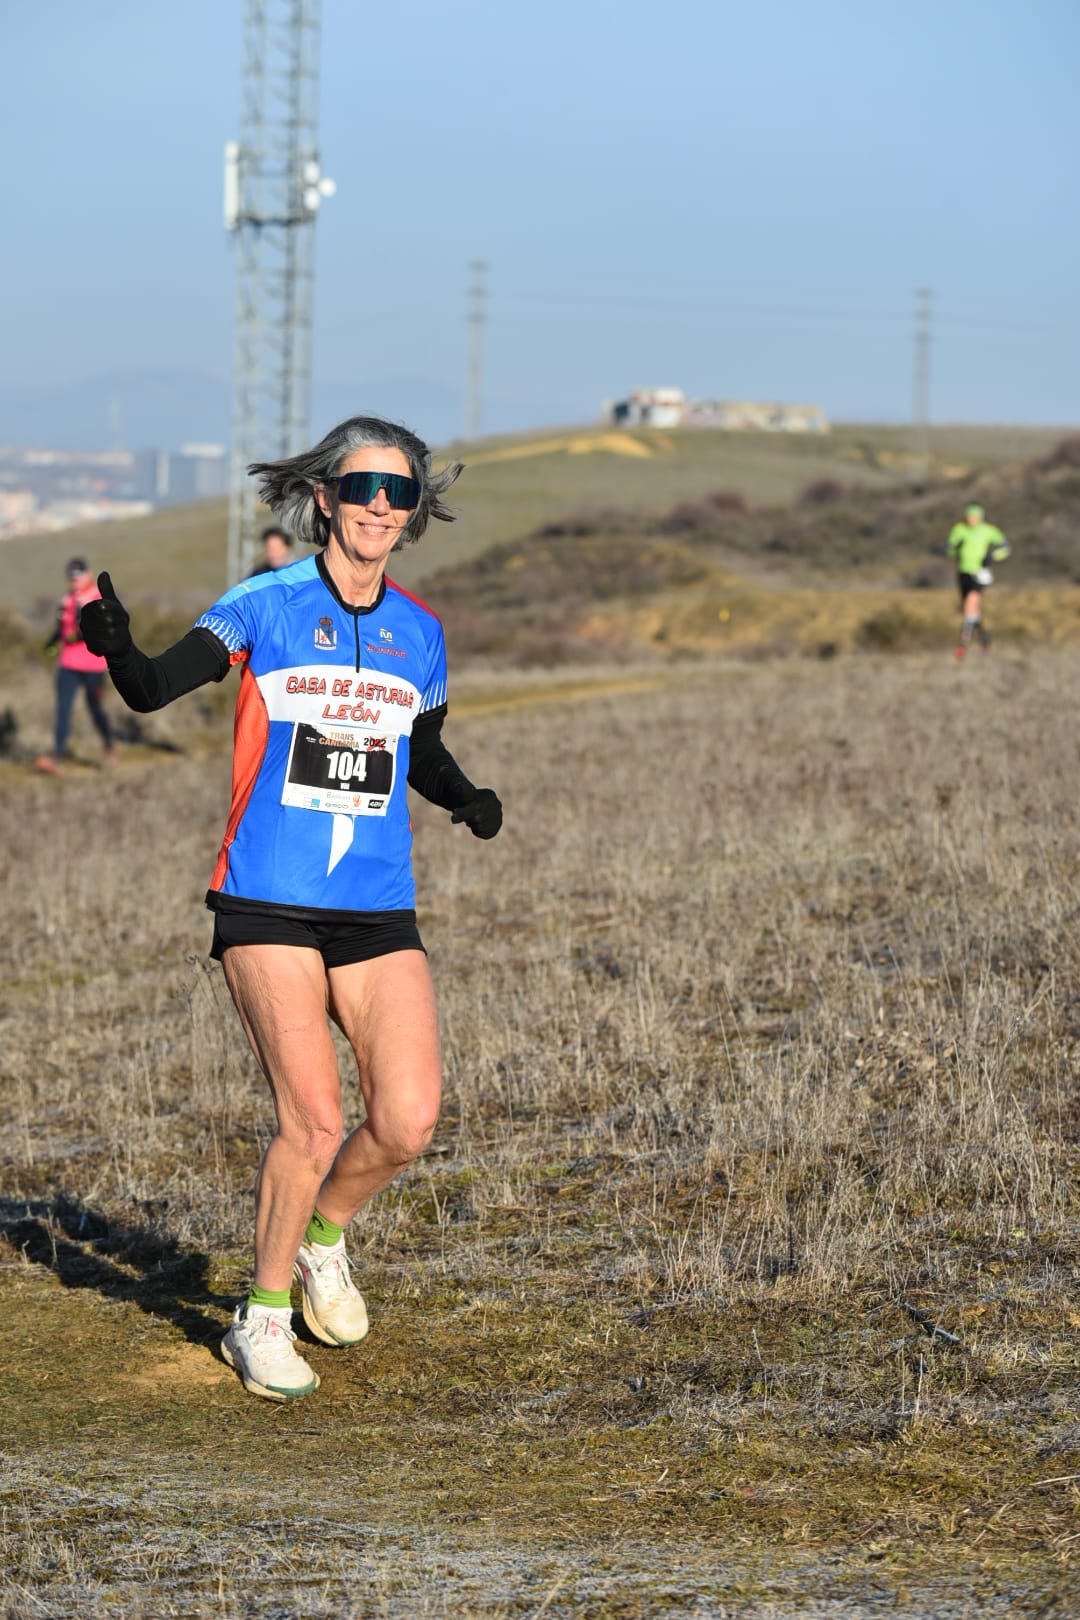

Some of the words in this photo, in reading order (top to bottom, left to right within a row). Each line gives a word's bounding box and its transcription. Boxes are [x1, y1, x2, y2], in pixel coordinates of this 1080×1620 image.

[286, 676, 326, 694] CASA
[332, 679, 352, 696] DE
[355, 682, 414, 708] ASTURIAS
[322, 701, 381, 724] LEÓN
[327, 751, 367, 782] 104
